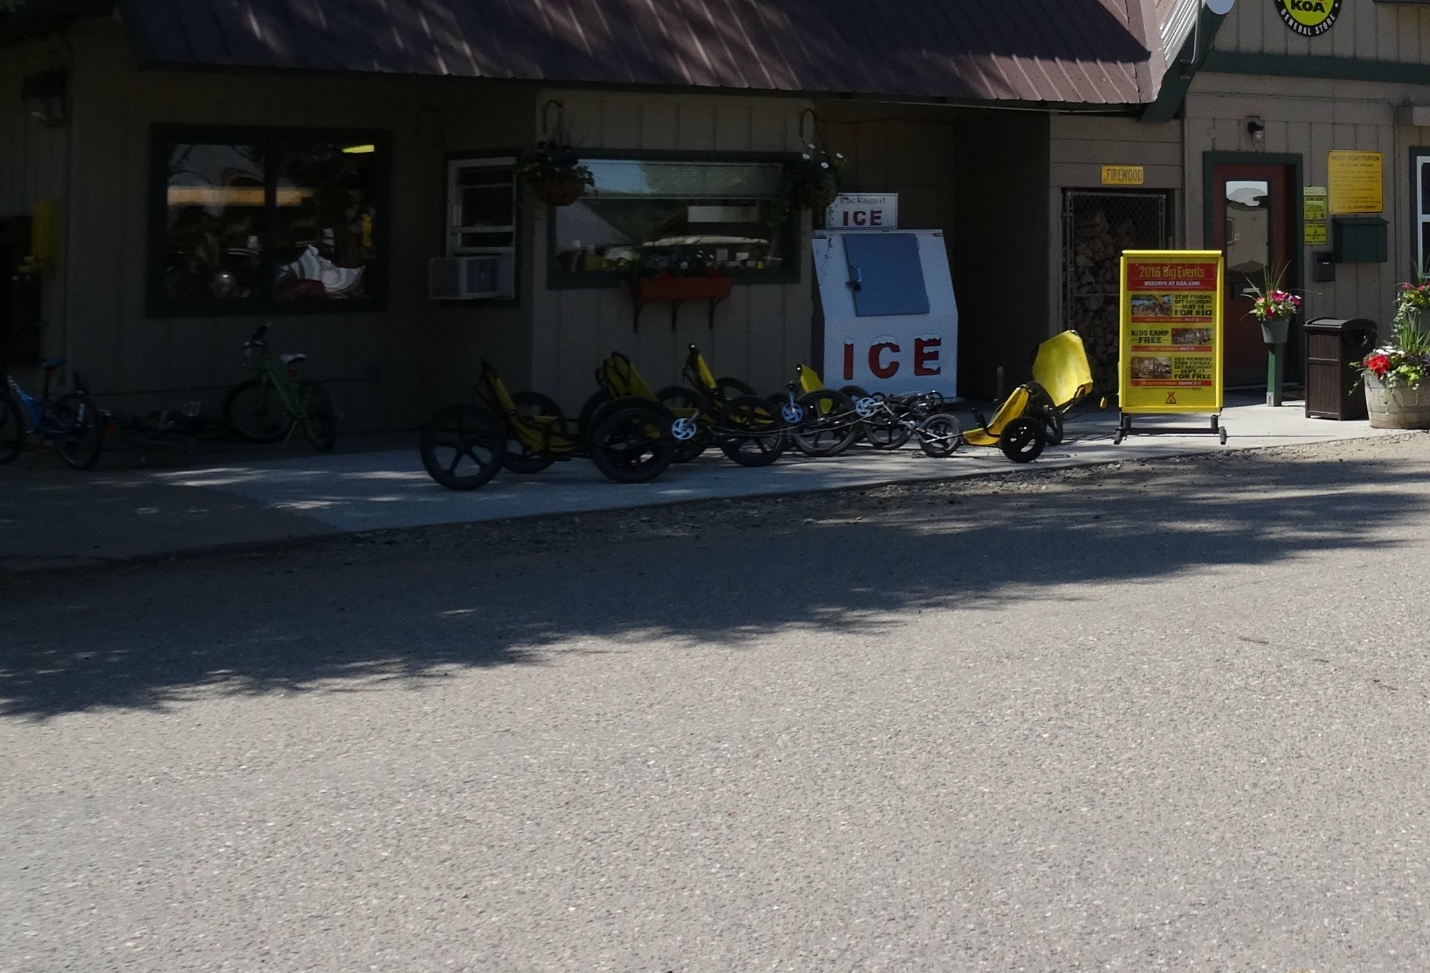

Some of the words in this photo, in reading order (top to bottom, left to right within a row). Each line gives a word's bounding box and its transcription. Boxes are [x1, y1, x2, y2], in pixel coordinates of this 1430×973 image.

[1281, 8, 1311, 35] GENERAL
[1315, 13, 1336, 34] STORE
[1106, 168, 1142, 182] FIREWOOD
[842, 209, 882, 226] ICE
[1139, 267, 1160, 278] 2016
[1162, 266, 1176, 279] Big
[1177, 267, 1205, 278] Events
[843, 333, 942, 381] ICE
